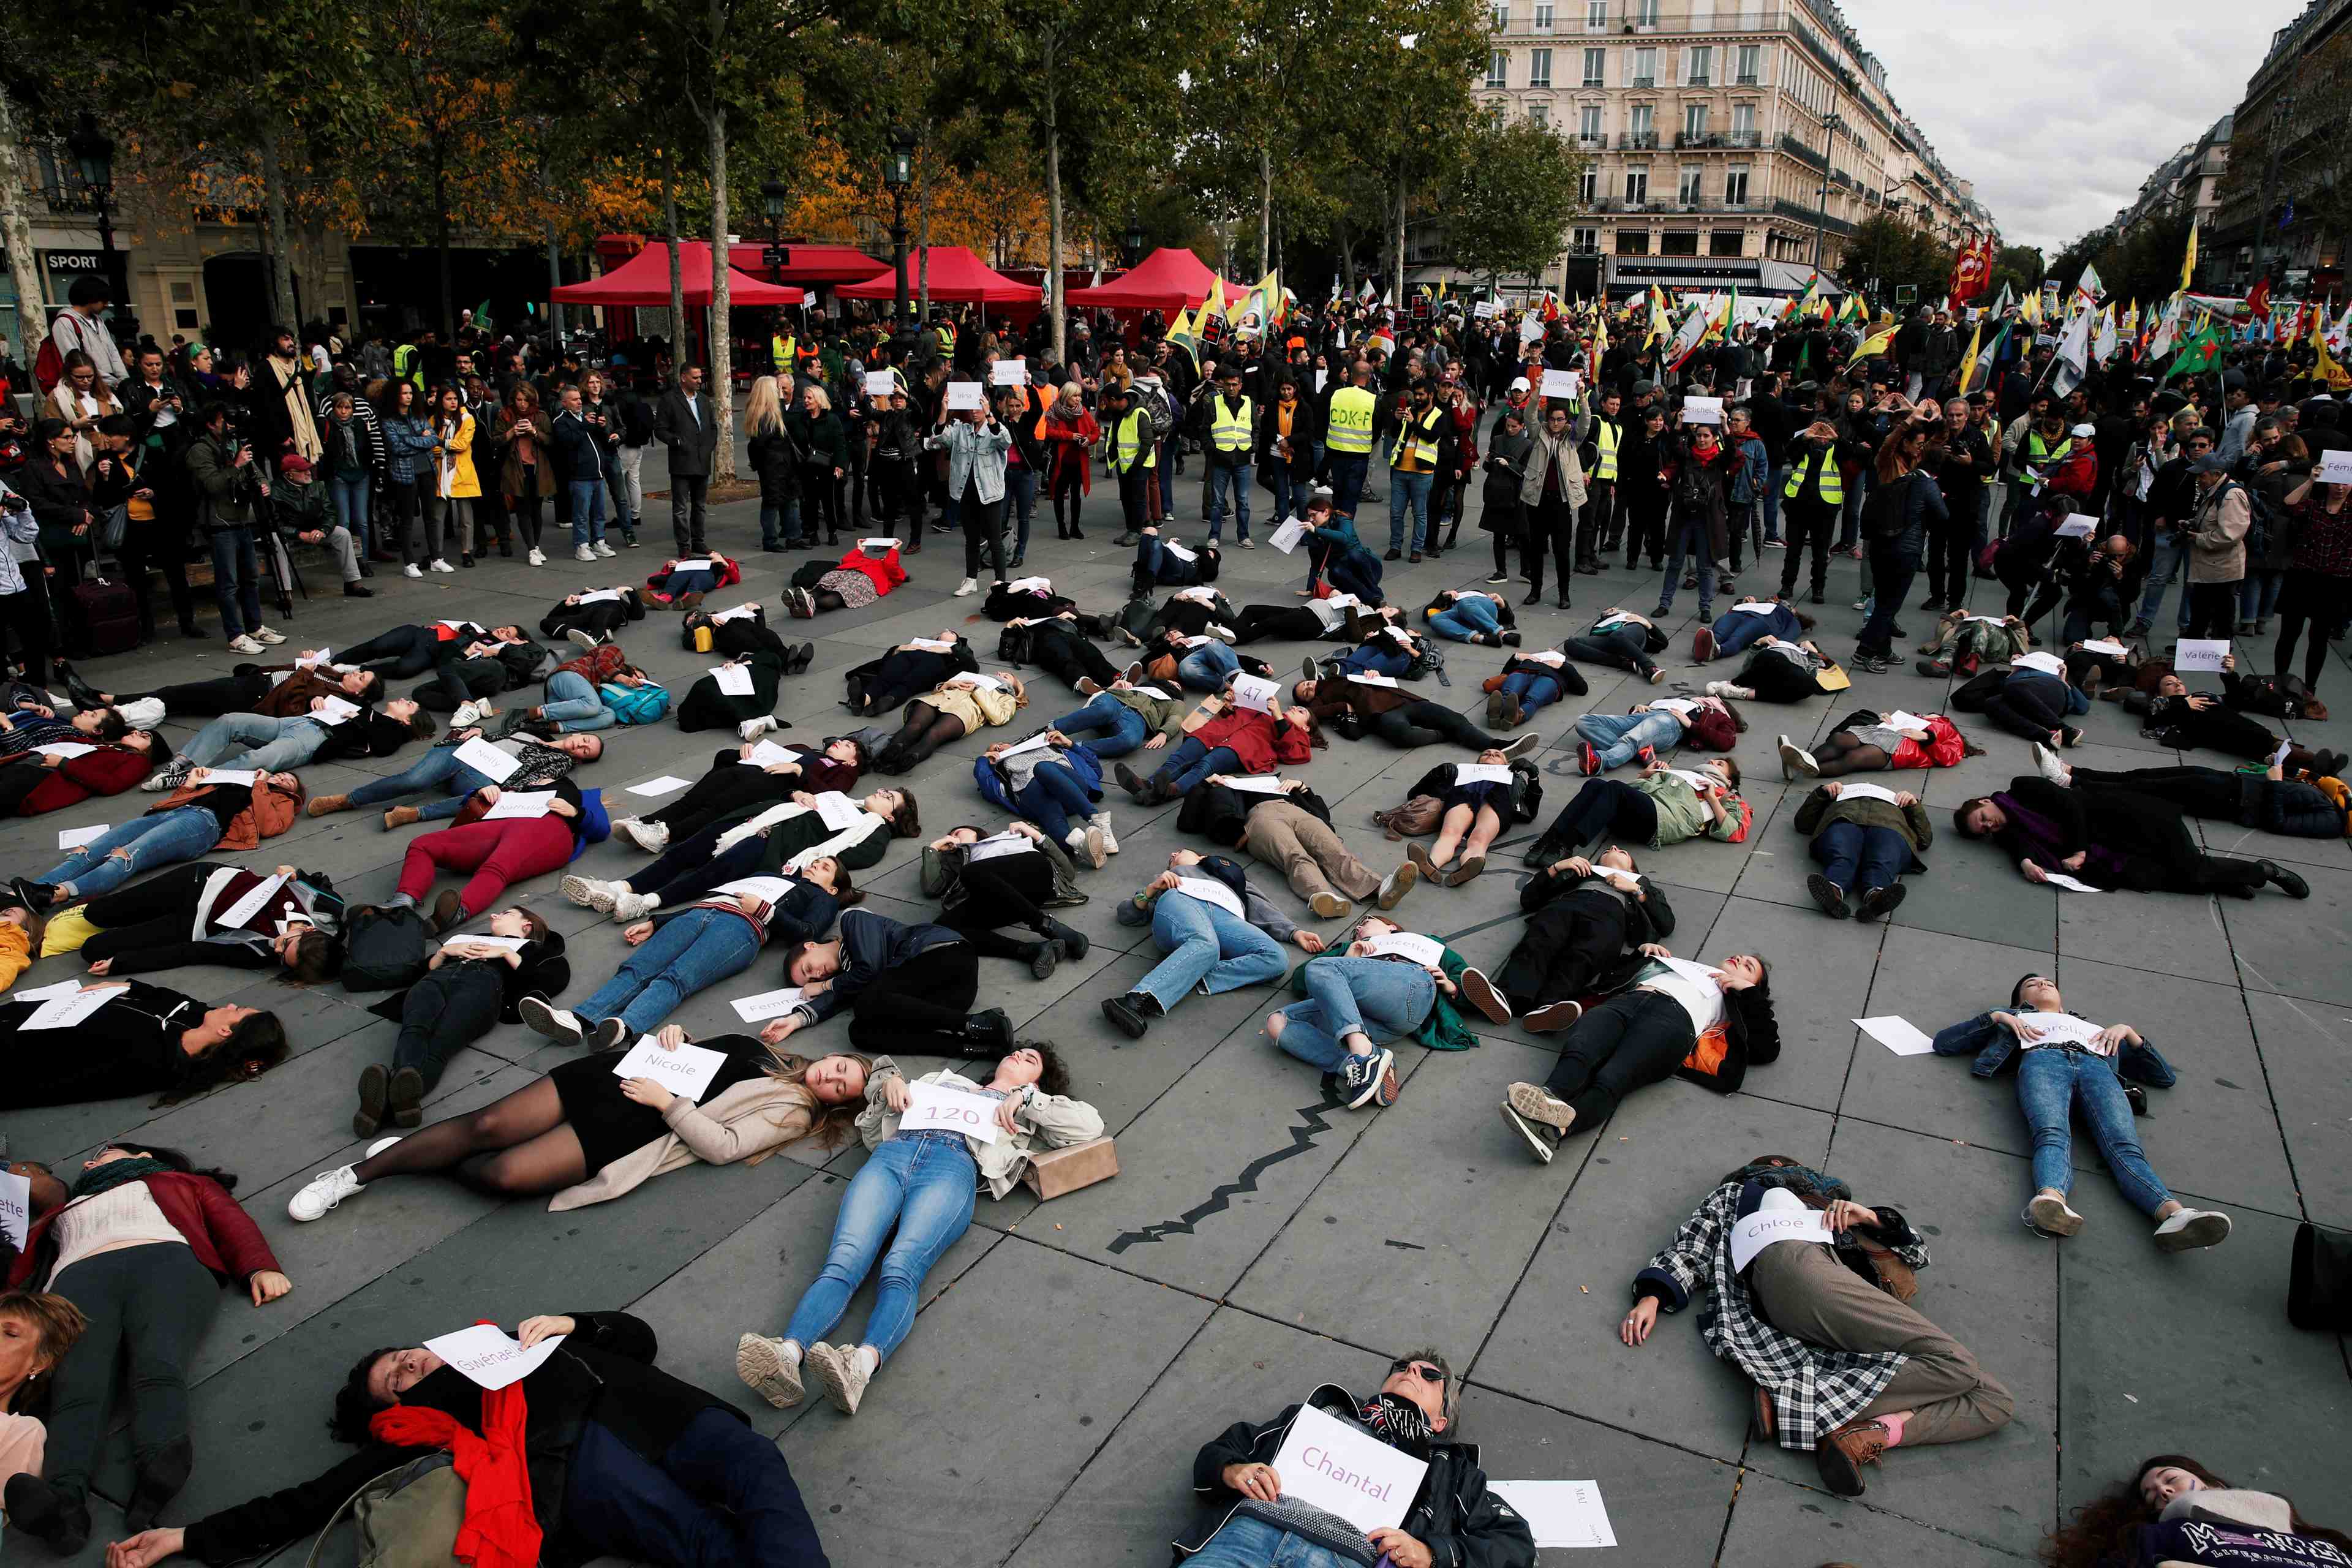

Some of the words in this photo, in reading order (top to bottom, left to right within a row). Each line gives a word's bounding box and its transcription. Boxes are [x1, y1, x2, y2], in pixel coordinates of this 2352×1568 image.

[49, 255, 98, 270] SPORT
[2185, 650, 2220, 661] Valérie
[1243, 686, 1262, 701] 47
[644, 1054, 696, 1076] Nicole
[924, 1106, 980, 1125] 120
[1748, 1216, 1804, 1238] Chloé
[1302, 1446, 1393, 1502] Chantal
